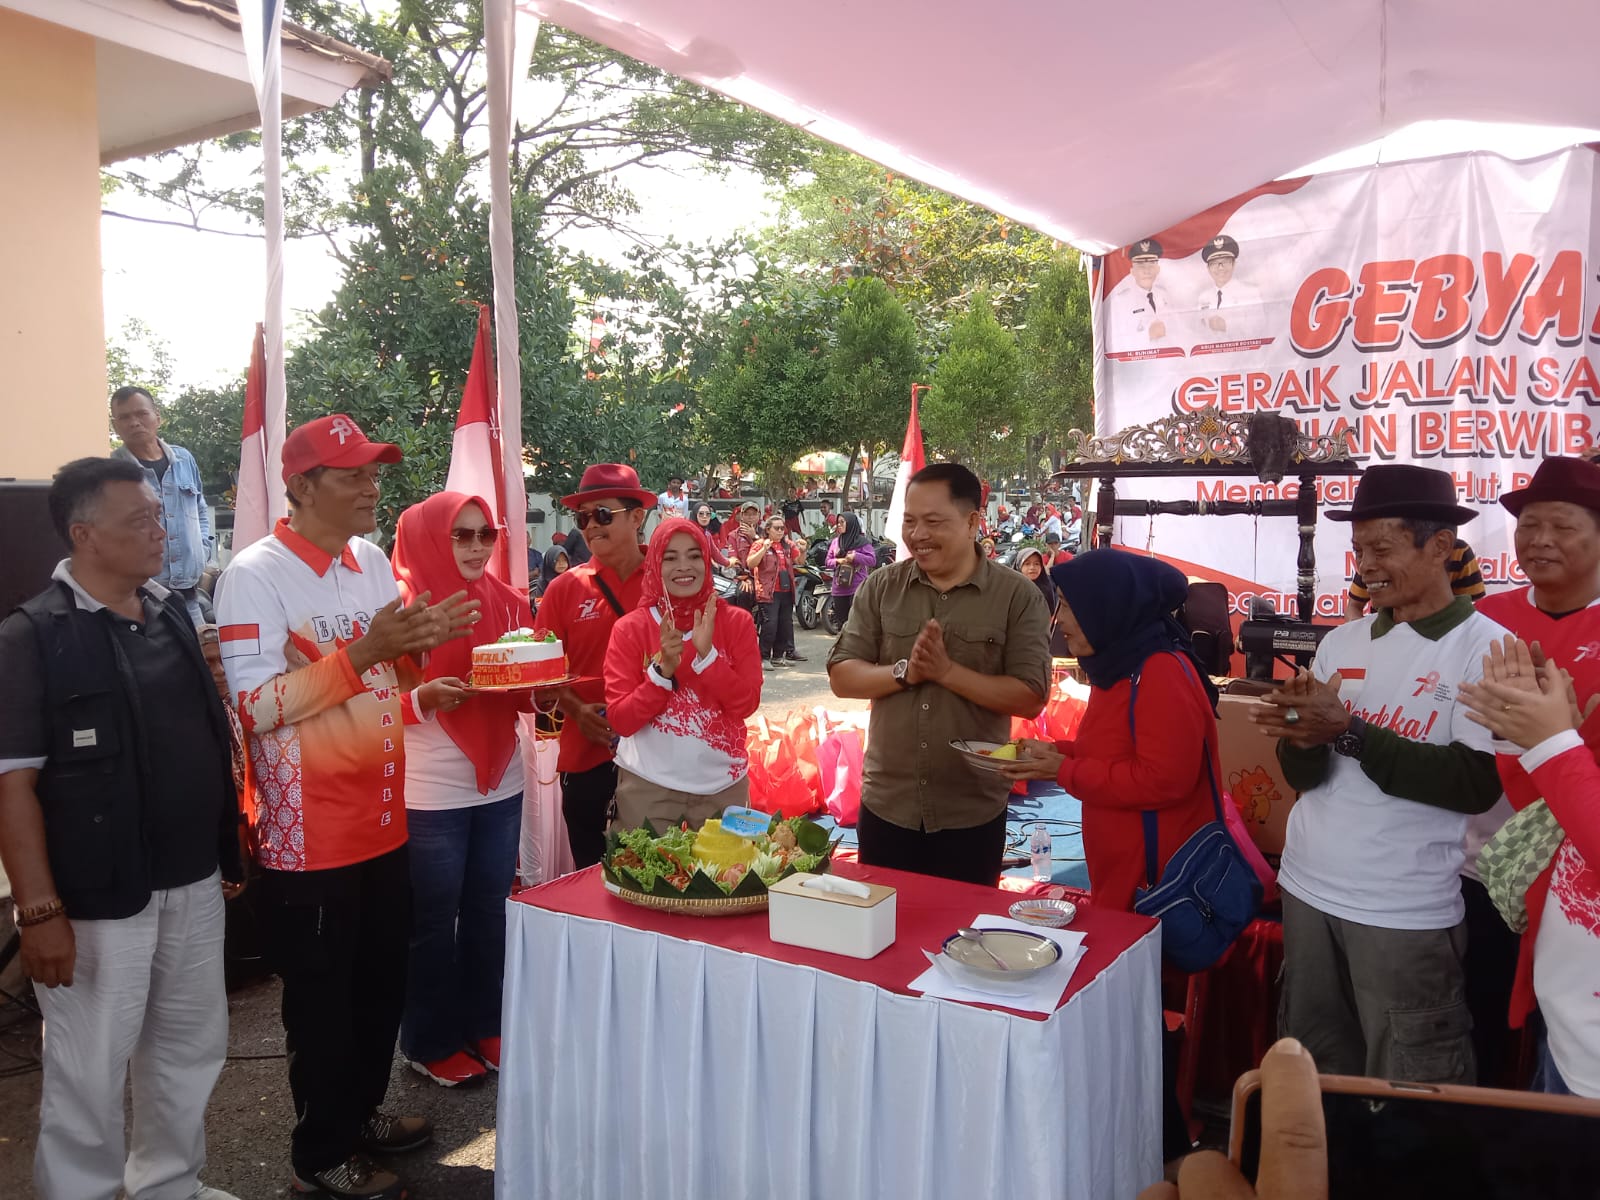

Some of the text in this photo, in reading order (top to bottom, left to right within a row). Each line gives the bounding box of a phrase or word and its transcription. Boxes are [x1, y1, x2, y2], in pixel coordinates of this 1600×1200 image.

[1289, 249, 1600, 356] GEBYA
[1176, 365, 1341, 414] GERAK
[1354, 355, 1517, 403] JALAN
[1417, 410, 1600, 456] BERWIB
[1451, 472, 1498, 502] Hut
[312, 607, 384, 643] BES
